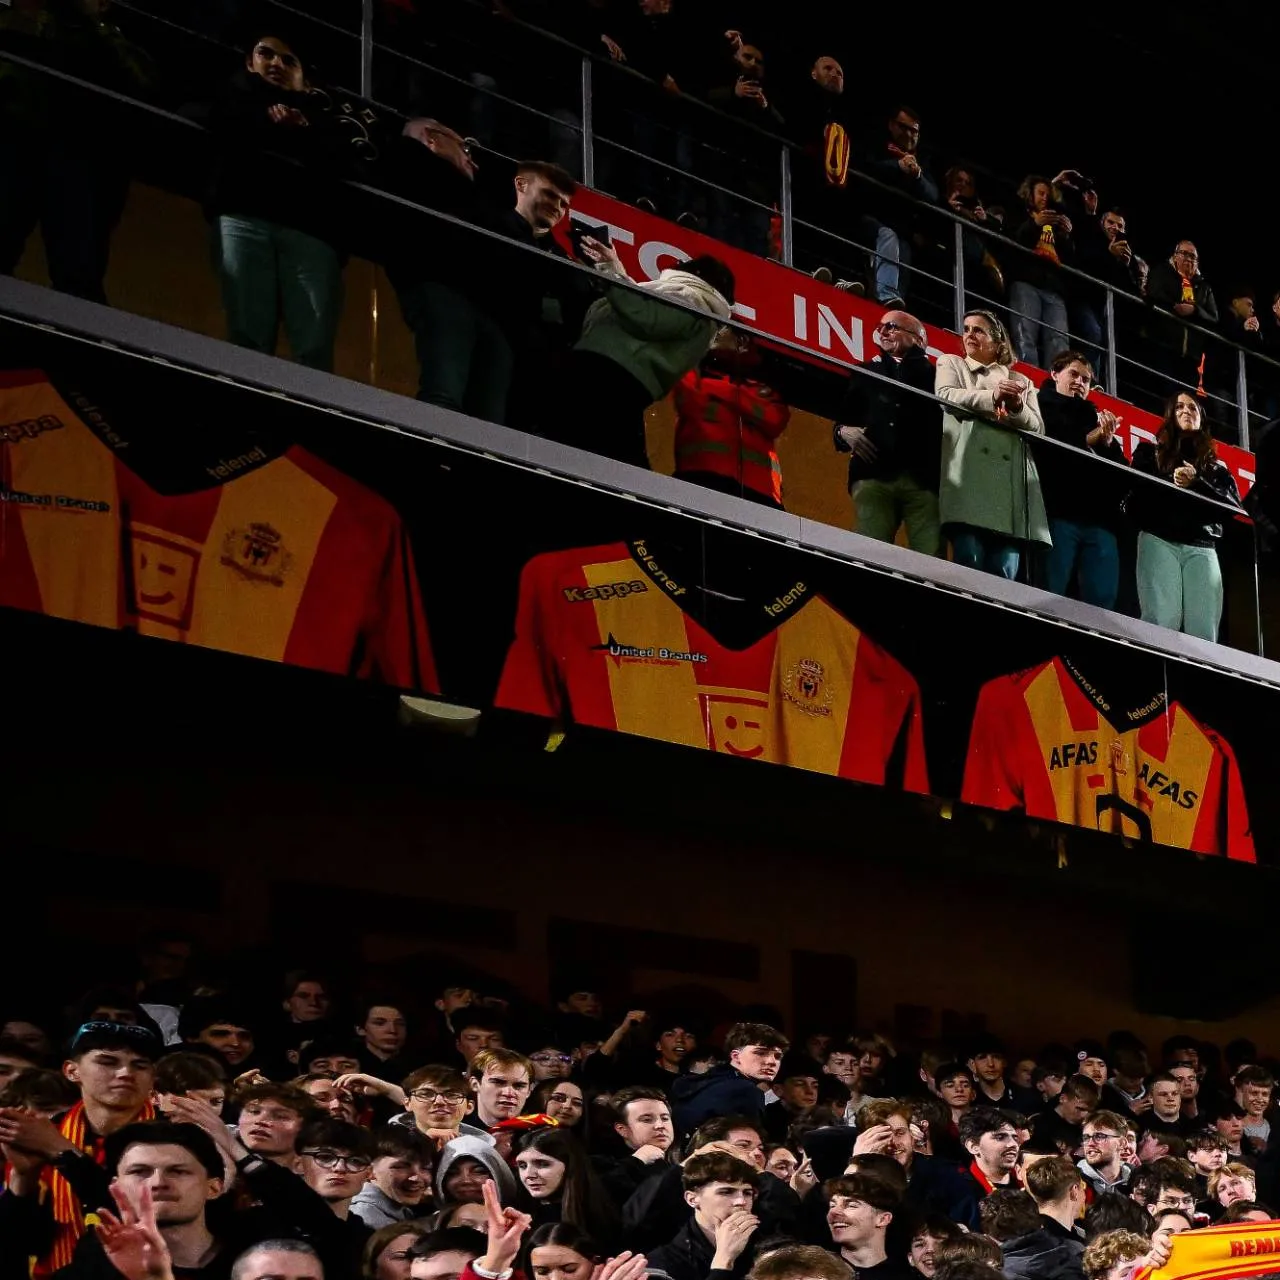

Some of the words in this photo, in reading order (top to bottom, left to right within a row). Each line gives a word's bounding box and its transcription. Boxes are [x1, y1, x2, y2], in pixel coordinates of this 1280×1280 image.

[564, 579, 649, 603] Kappa
[763, 579, 809, 619] telene
[609, 645, 654, 659] United
[659, 648, 709, 664] Brands
[1049, 741, 1099, 772] AFAS
[1137, 763, 1199, 830] AFAS
